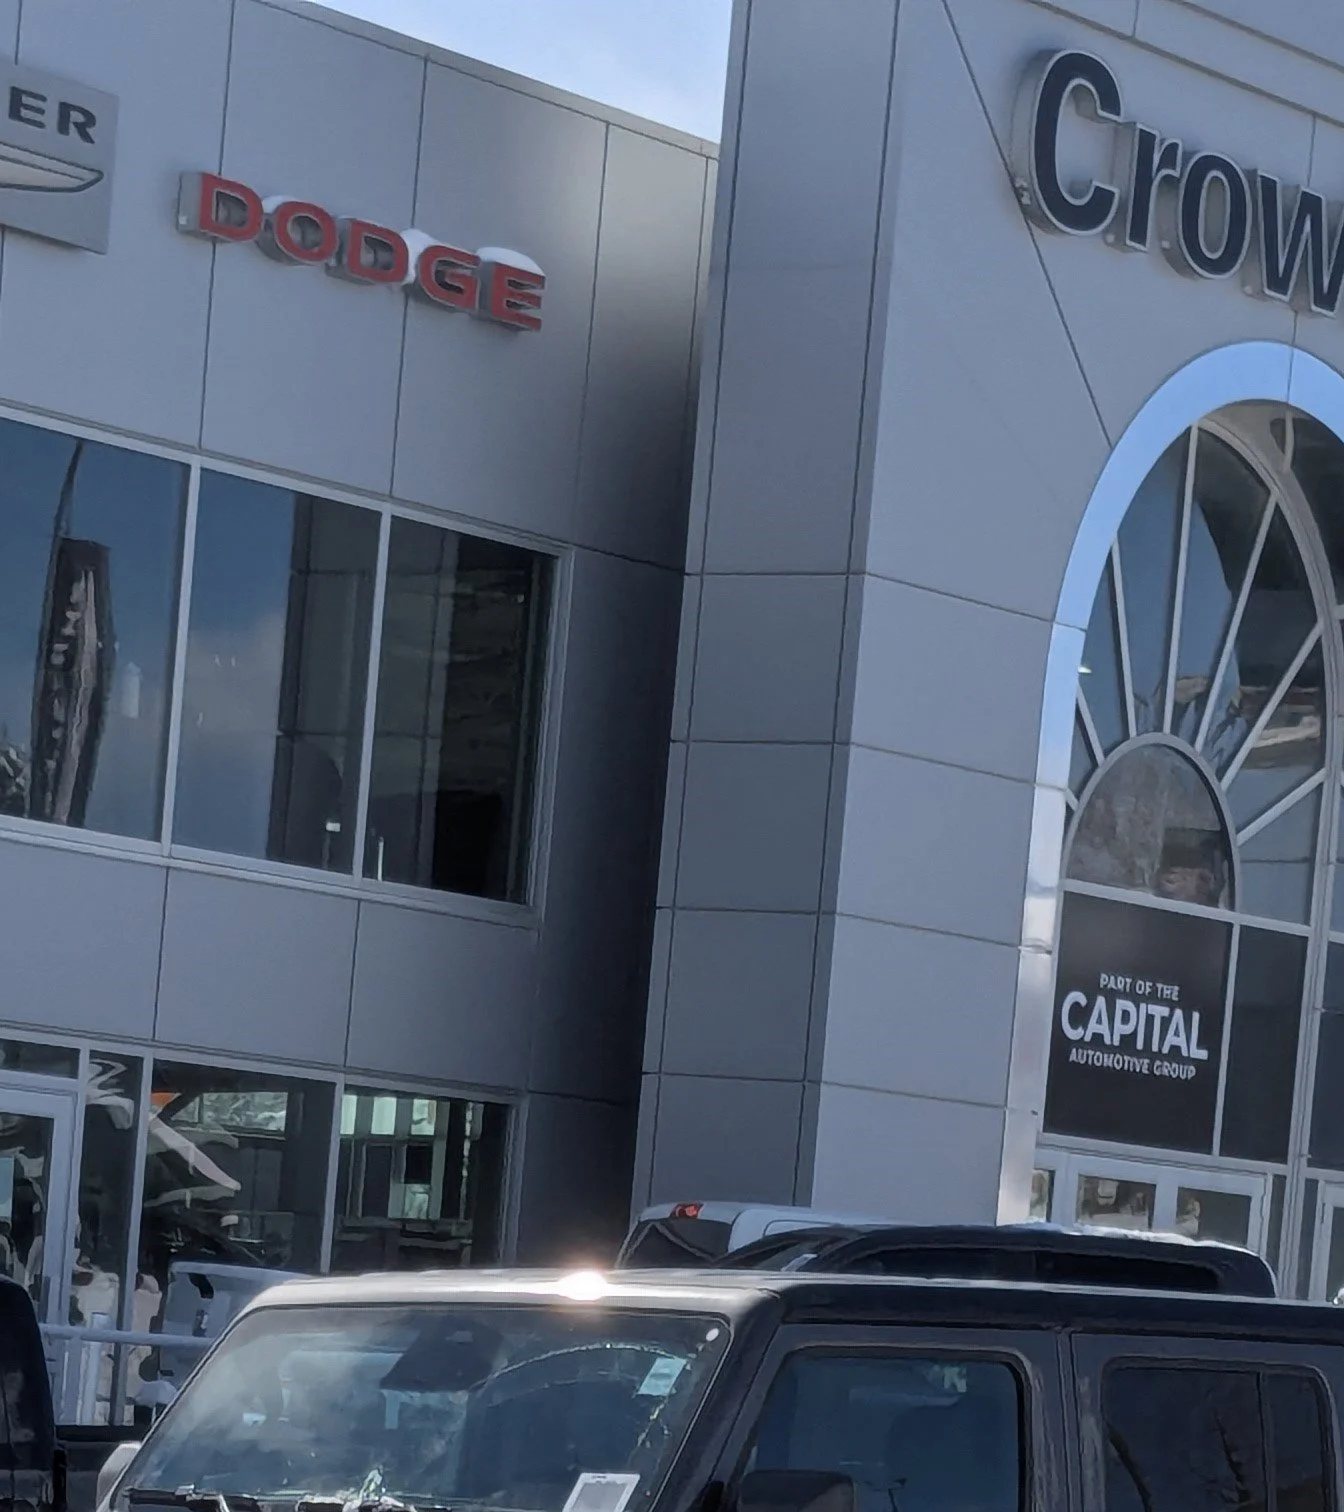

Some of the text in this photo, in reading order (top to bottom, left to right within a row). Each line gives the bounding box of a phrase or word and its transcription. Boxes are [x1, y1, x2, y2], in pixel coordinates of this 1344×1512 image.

[196, 171, 546, 332] DODGE
[1099, 973, 1180, 1001] PART OF THE
[1061, 991, 1209, 1060] CAPITAL
[1069, 1048, 1196, 1080] AUTOMOTIVE GROUP
